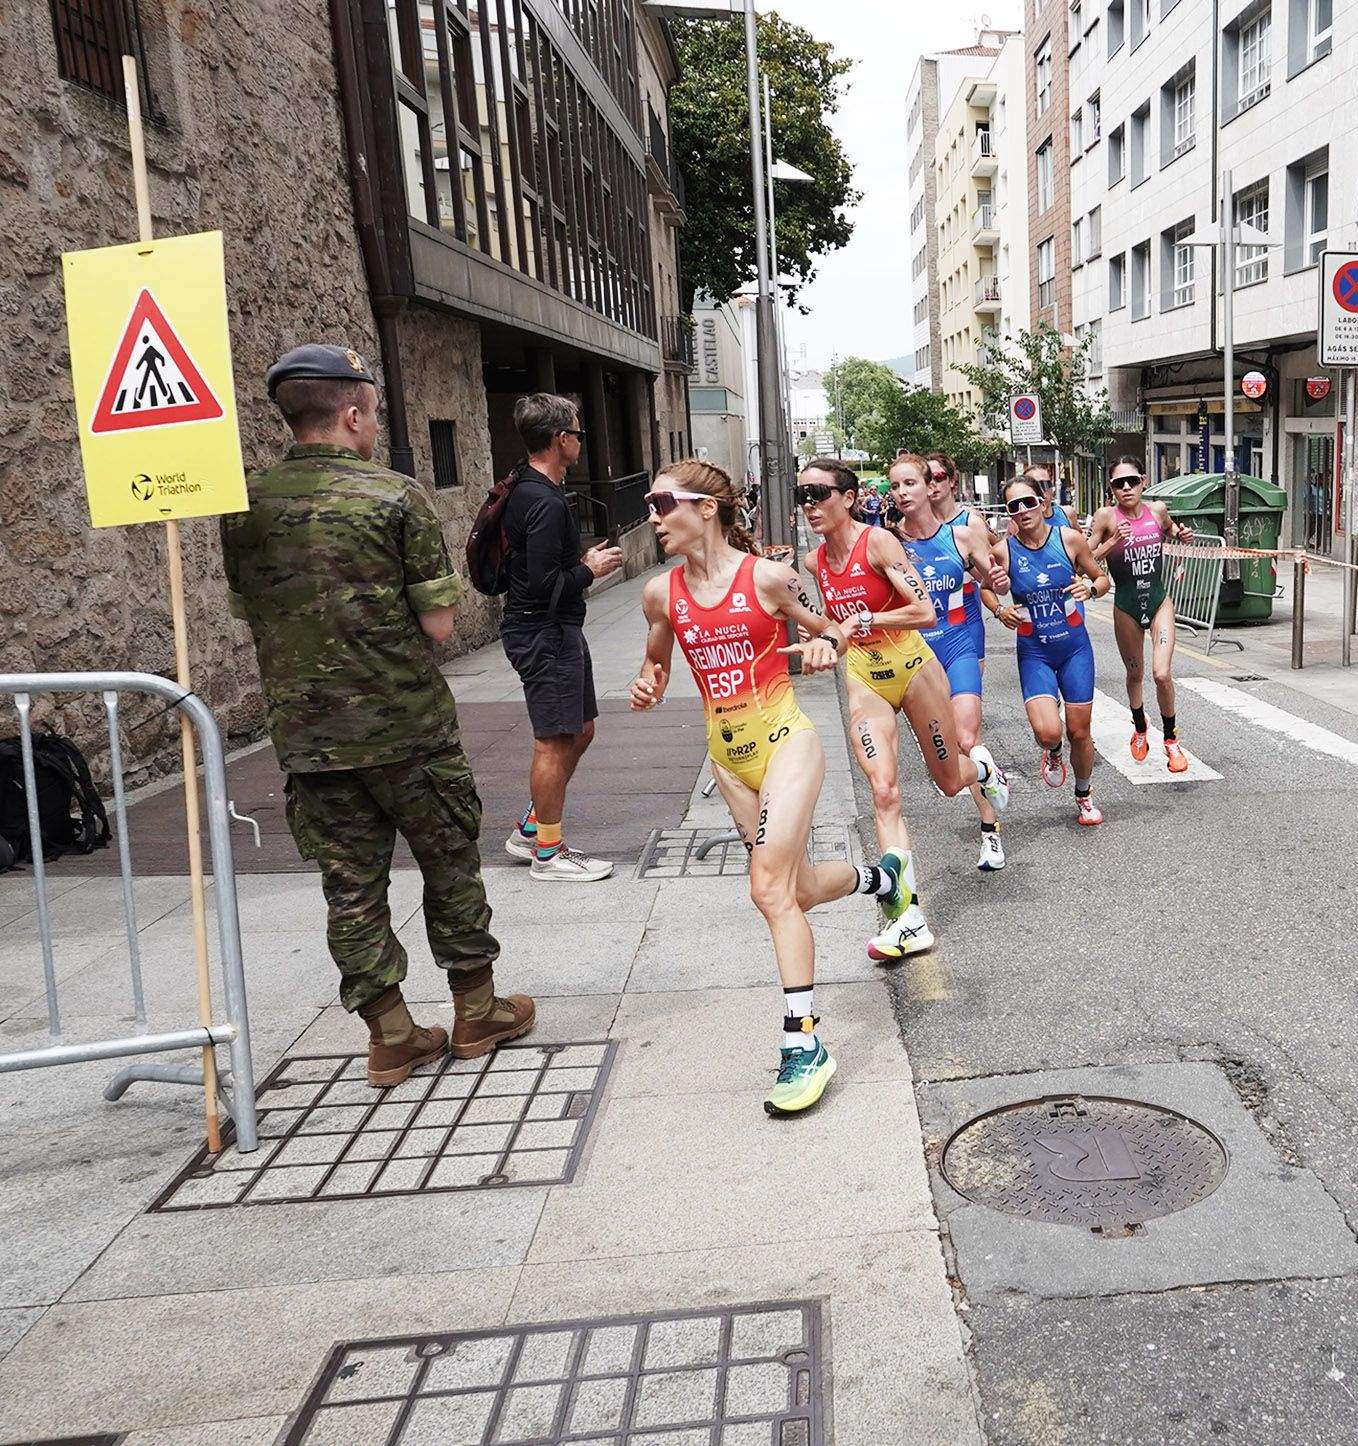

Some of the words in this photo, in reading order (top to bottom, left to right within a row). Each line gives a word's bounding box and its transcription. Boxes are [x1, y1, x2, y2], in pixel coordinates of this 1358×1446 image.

[702, 319, 719, 384] CASTELAO
[1327, 344, 1347, 352] AGÁS
[156, 472, 186, 484] World
[157, 483, 201, 496] Triathlon
[1124, 542, 1161, 563] ALVAREZ
[1131, 558, 1156, 576] MEX
[1032, 602, 1063, 619] ITA
[699, 630, 710, 639] LA
[715, 624, 749, 635] NUCIA
[688, 640, 755, 670] REIMONDO
[707, 669, 744, 699] ESP
[755, 809, 768, 845] 82
